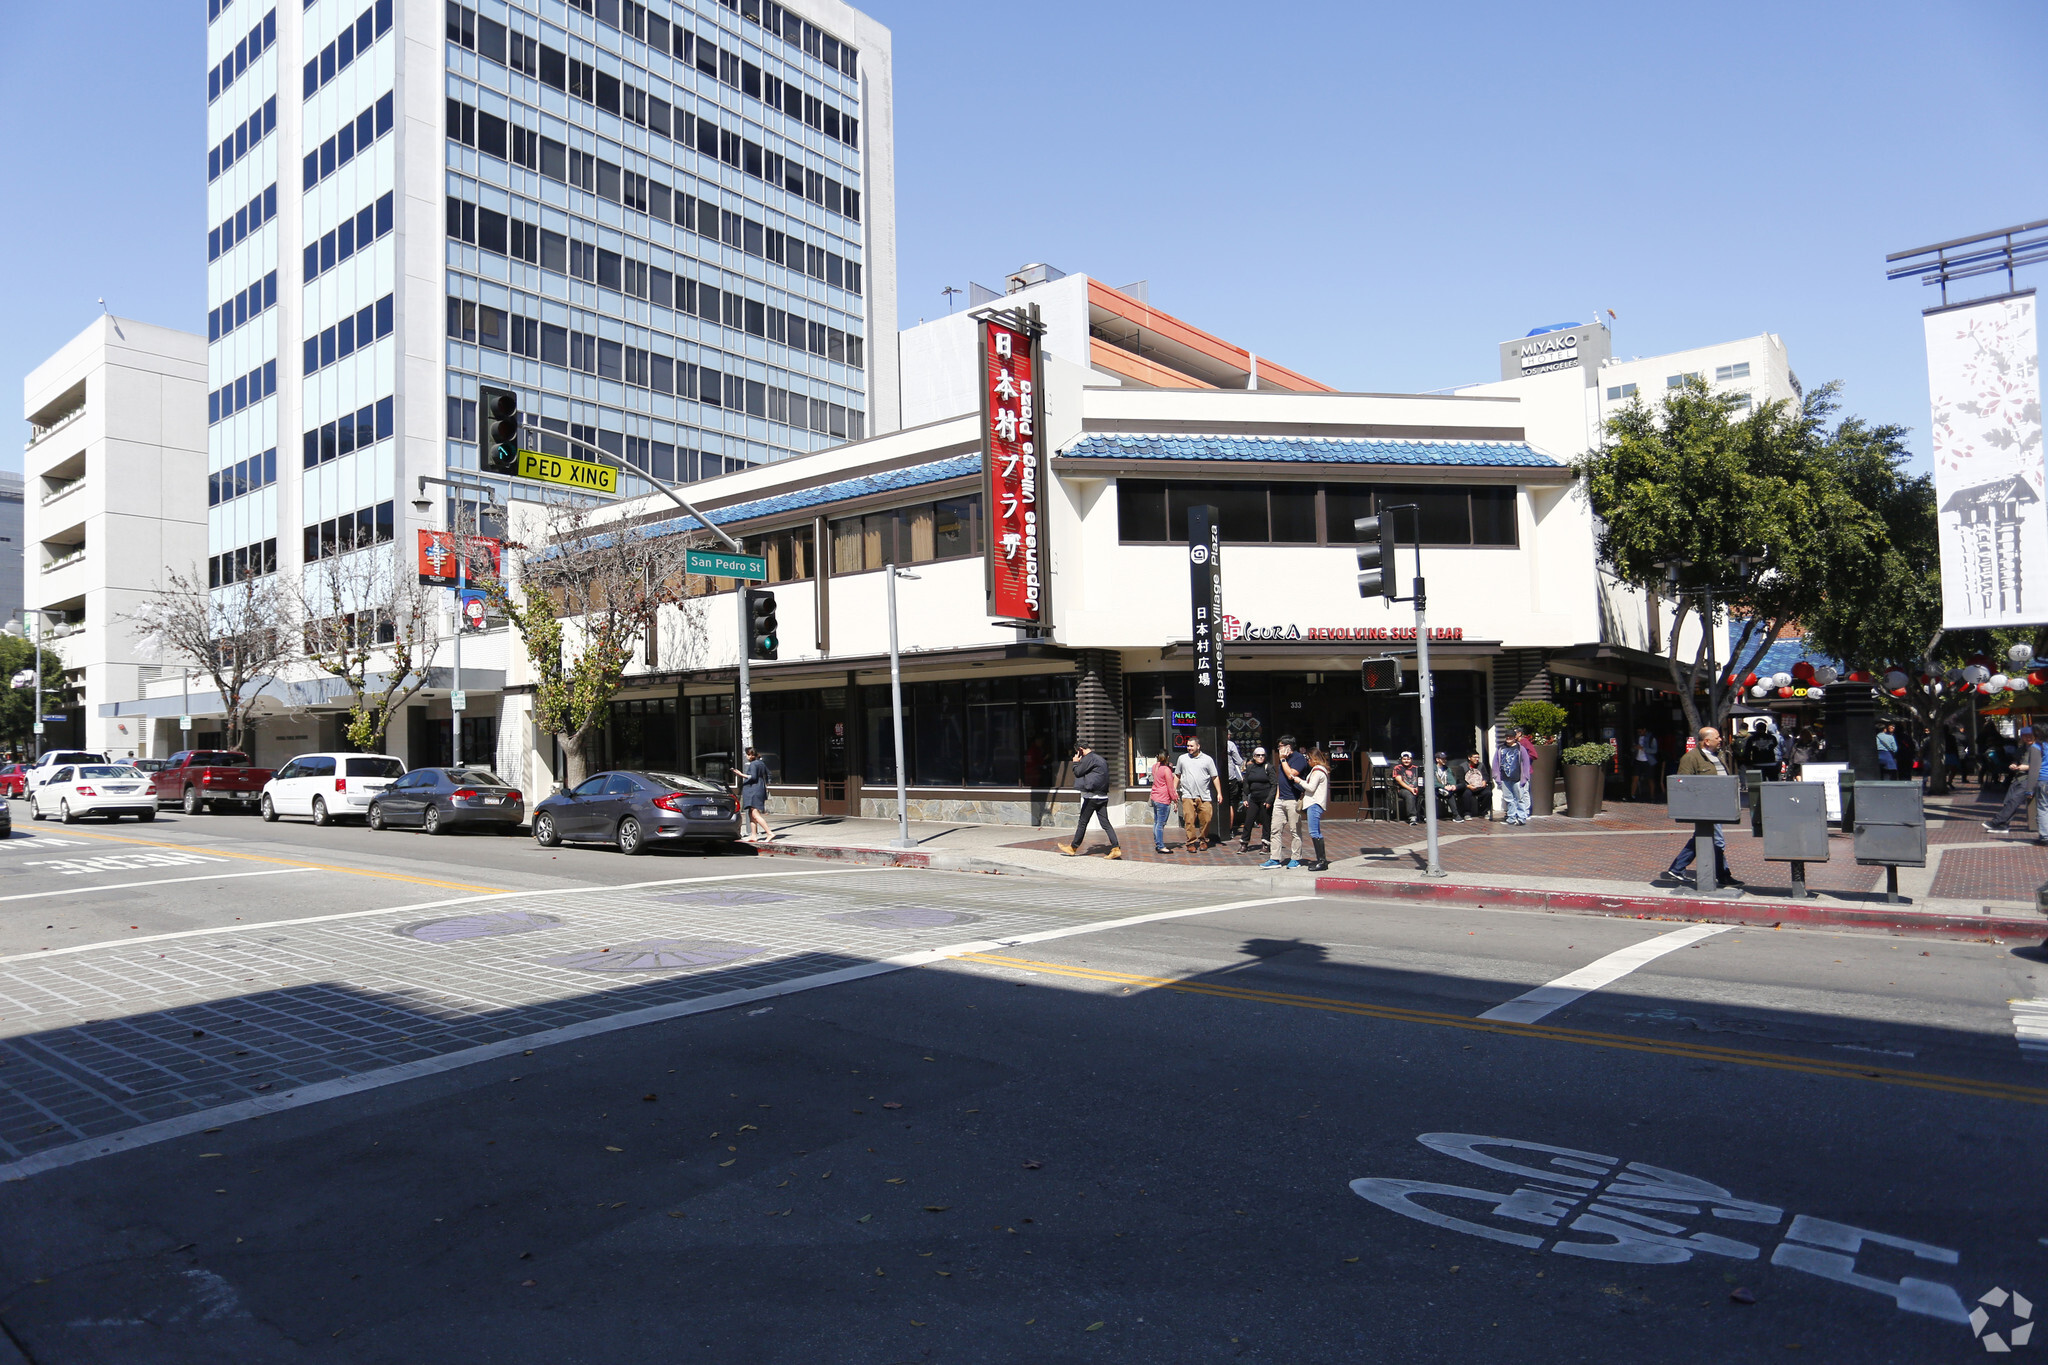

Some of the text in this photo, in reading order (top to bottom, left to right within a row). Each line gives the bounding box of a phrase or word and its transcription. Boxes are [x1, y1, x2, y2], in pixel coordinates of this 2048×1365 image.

[1521, 335, 1577, 357] MIYAKO
[1528, 350, 1570, 365] HOTEL
[1521, 360, 1578, 377] LOS ANGELES
[994, 333, 1021, 559] 日本村プラザ
[526, 456, 609, 487] PED XING
[1021, 442, 1036, 504] Village
[691, 556, 761, 573] San Pedro St
[1025, 511, 1038, 612] Japanese
[1213, 574, 1222, 624] Village
[1196, 607, 1211, 686] 日本村広場
[1308, 627, 1387, 640] REVOLVING
[1391, 627, 1433, 640] SUSI
[1437, 627, 1463, 640] BAR
[1215, 632, 1225, 708] Japanese
